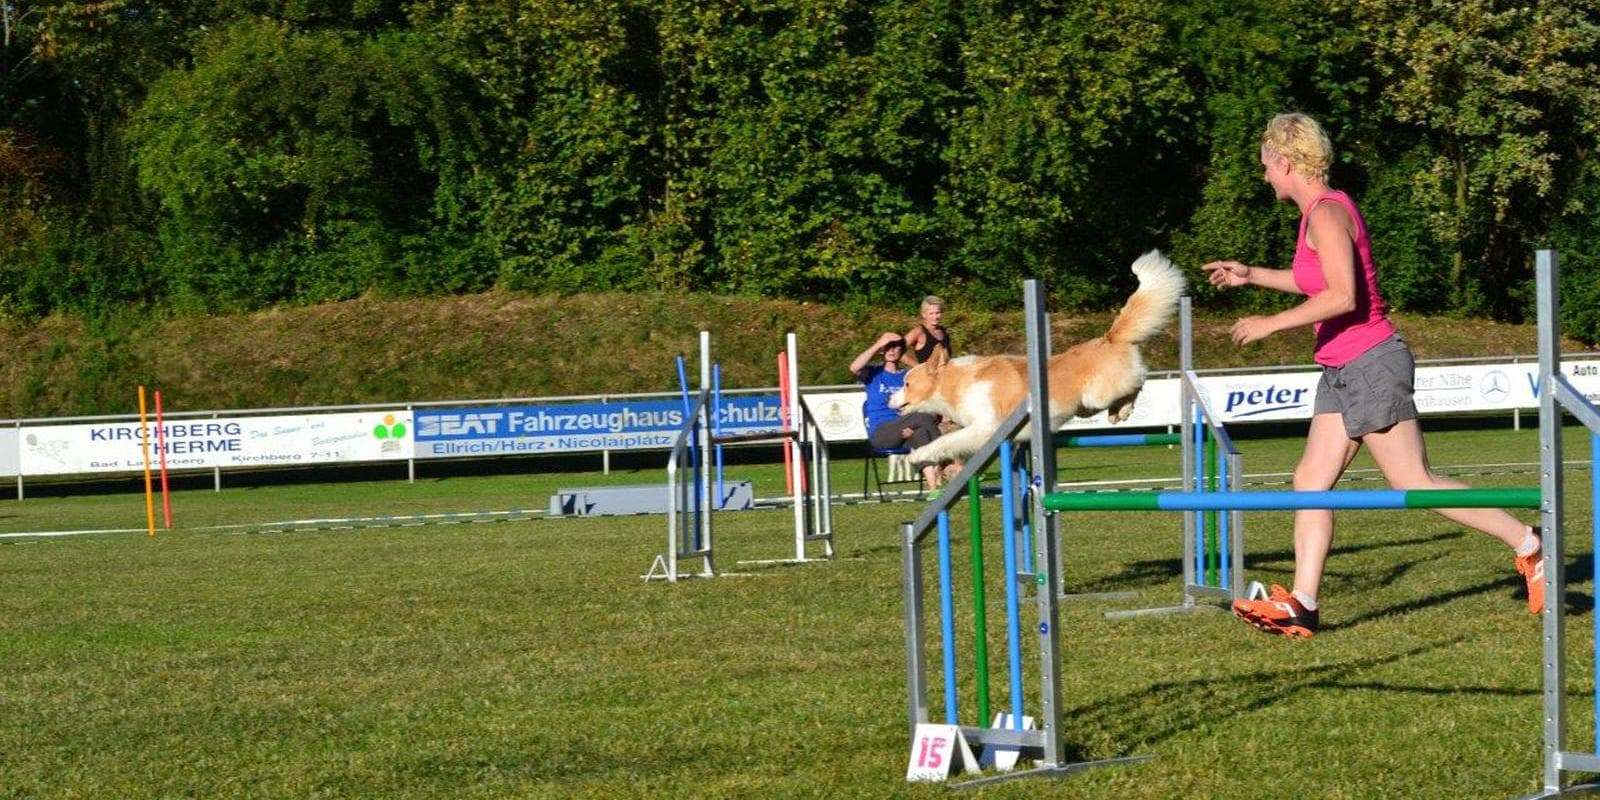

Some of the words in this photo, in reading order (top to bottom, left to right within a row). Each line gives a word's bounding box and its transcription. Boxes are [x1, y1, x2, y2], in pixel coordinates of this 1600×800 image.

[1573, 365, 1598, 376] Auto
[1224, 384, 1309, 412] peter
[417, 412, 503, 437] SEAT
[508, 408, 683, 433] Fahrzeughaus
[698, 402, 791, 425] chulze
[90, 422, 241, 441] KIRCHBERG
[432, 440, 545, 454] Ellrich/Harz
[558, 434, 671, 449] Nicolaiplatz
[127, 457, 205, 468] Latrberg
[917, 737, 947, 768] 15
